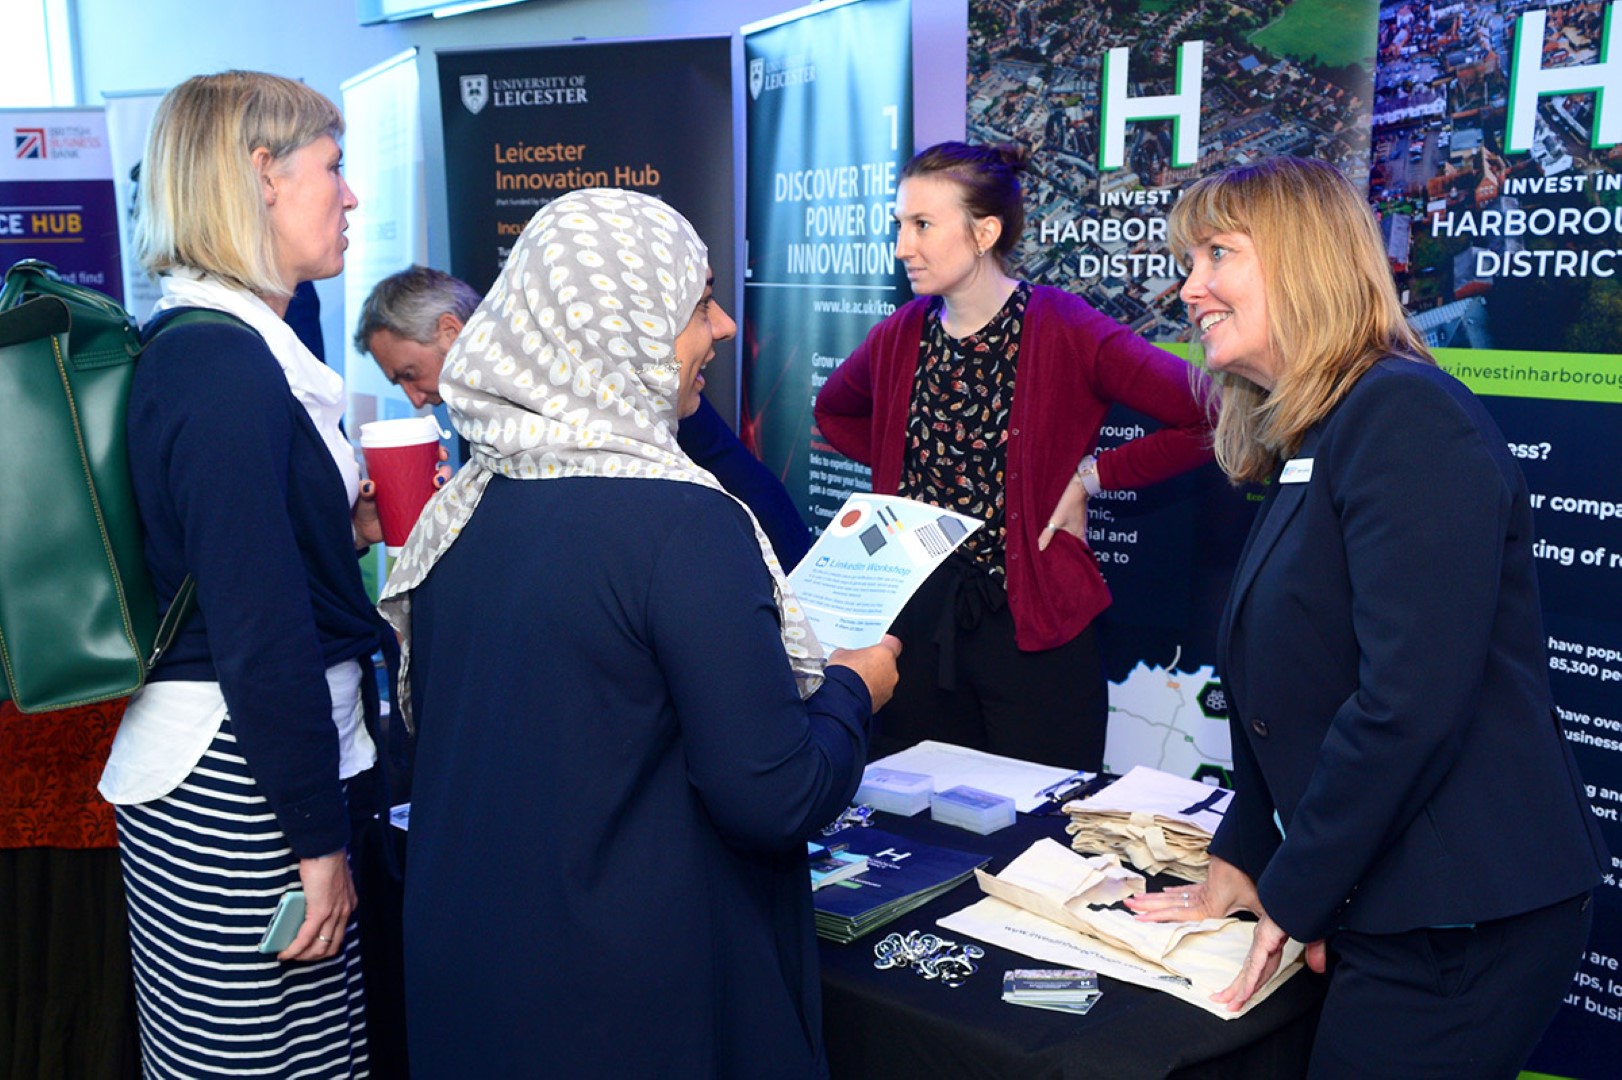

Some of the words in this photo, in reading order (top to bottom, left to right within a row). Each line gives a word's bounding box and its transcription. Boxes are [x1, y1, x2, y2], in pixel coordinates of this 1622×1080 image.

[493, 77, 566, 90] UNIVERSITY
[569, 75, 587, 87] OF
[1504, 0, 1622, 155] H
[493, 88, 588, 107] LEICESTER
[1100, 40, 1204, 171] H
[494, 142, 586, 163] Leicester
[496, 167, 608, 190] Innovation
[615, 164, 660, 186] Hub
[775, 166, 858, 202] DISCOVER
[861, 162, 897, 195] THE
[1503, 175, 1588, 194] INVEST
[1596, 172, 1622, 191] IN
[1100, 190, 1171, 206] INVEST
[31, 213, 82, 234] HUB
[805, 203, 866, 237] POWER
[870, 202, 896, 235] OF
[1040, 217, 1167, 243] HARBOR
[788, 242, 895, 275] INNOVATION
[1476, 249, 1622, 278] DISTRIC
[812, 352, 834, 368] Grow
[1442, 362, 1622, 389] .investinharborou
[1087, 527, 1105, 540] ial
[1108, 531, 1138, 544] and
[1113, 551, 1129, 563] to
[1580, 547, 1606, 566] of
[866, 562, 911, 577] Workshop
[1548, 636, 1584, 654] have
[1549, 656, 1599, 677] 85,300
[1601, 668, 1622, 682] pe
[1593, 716, 1622, 733] ove
[1589, 951, 1619, 971] are
